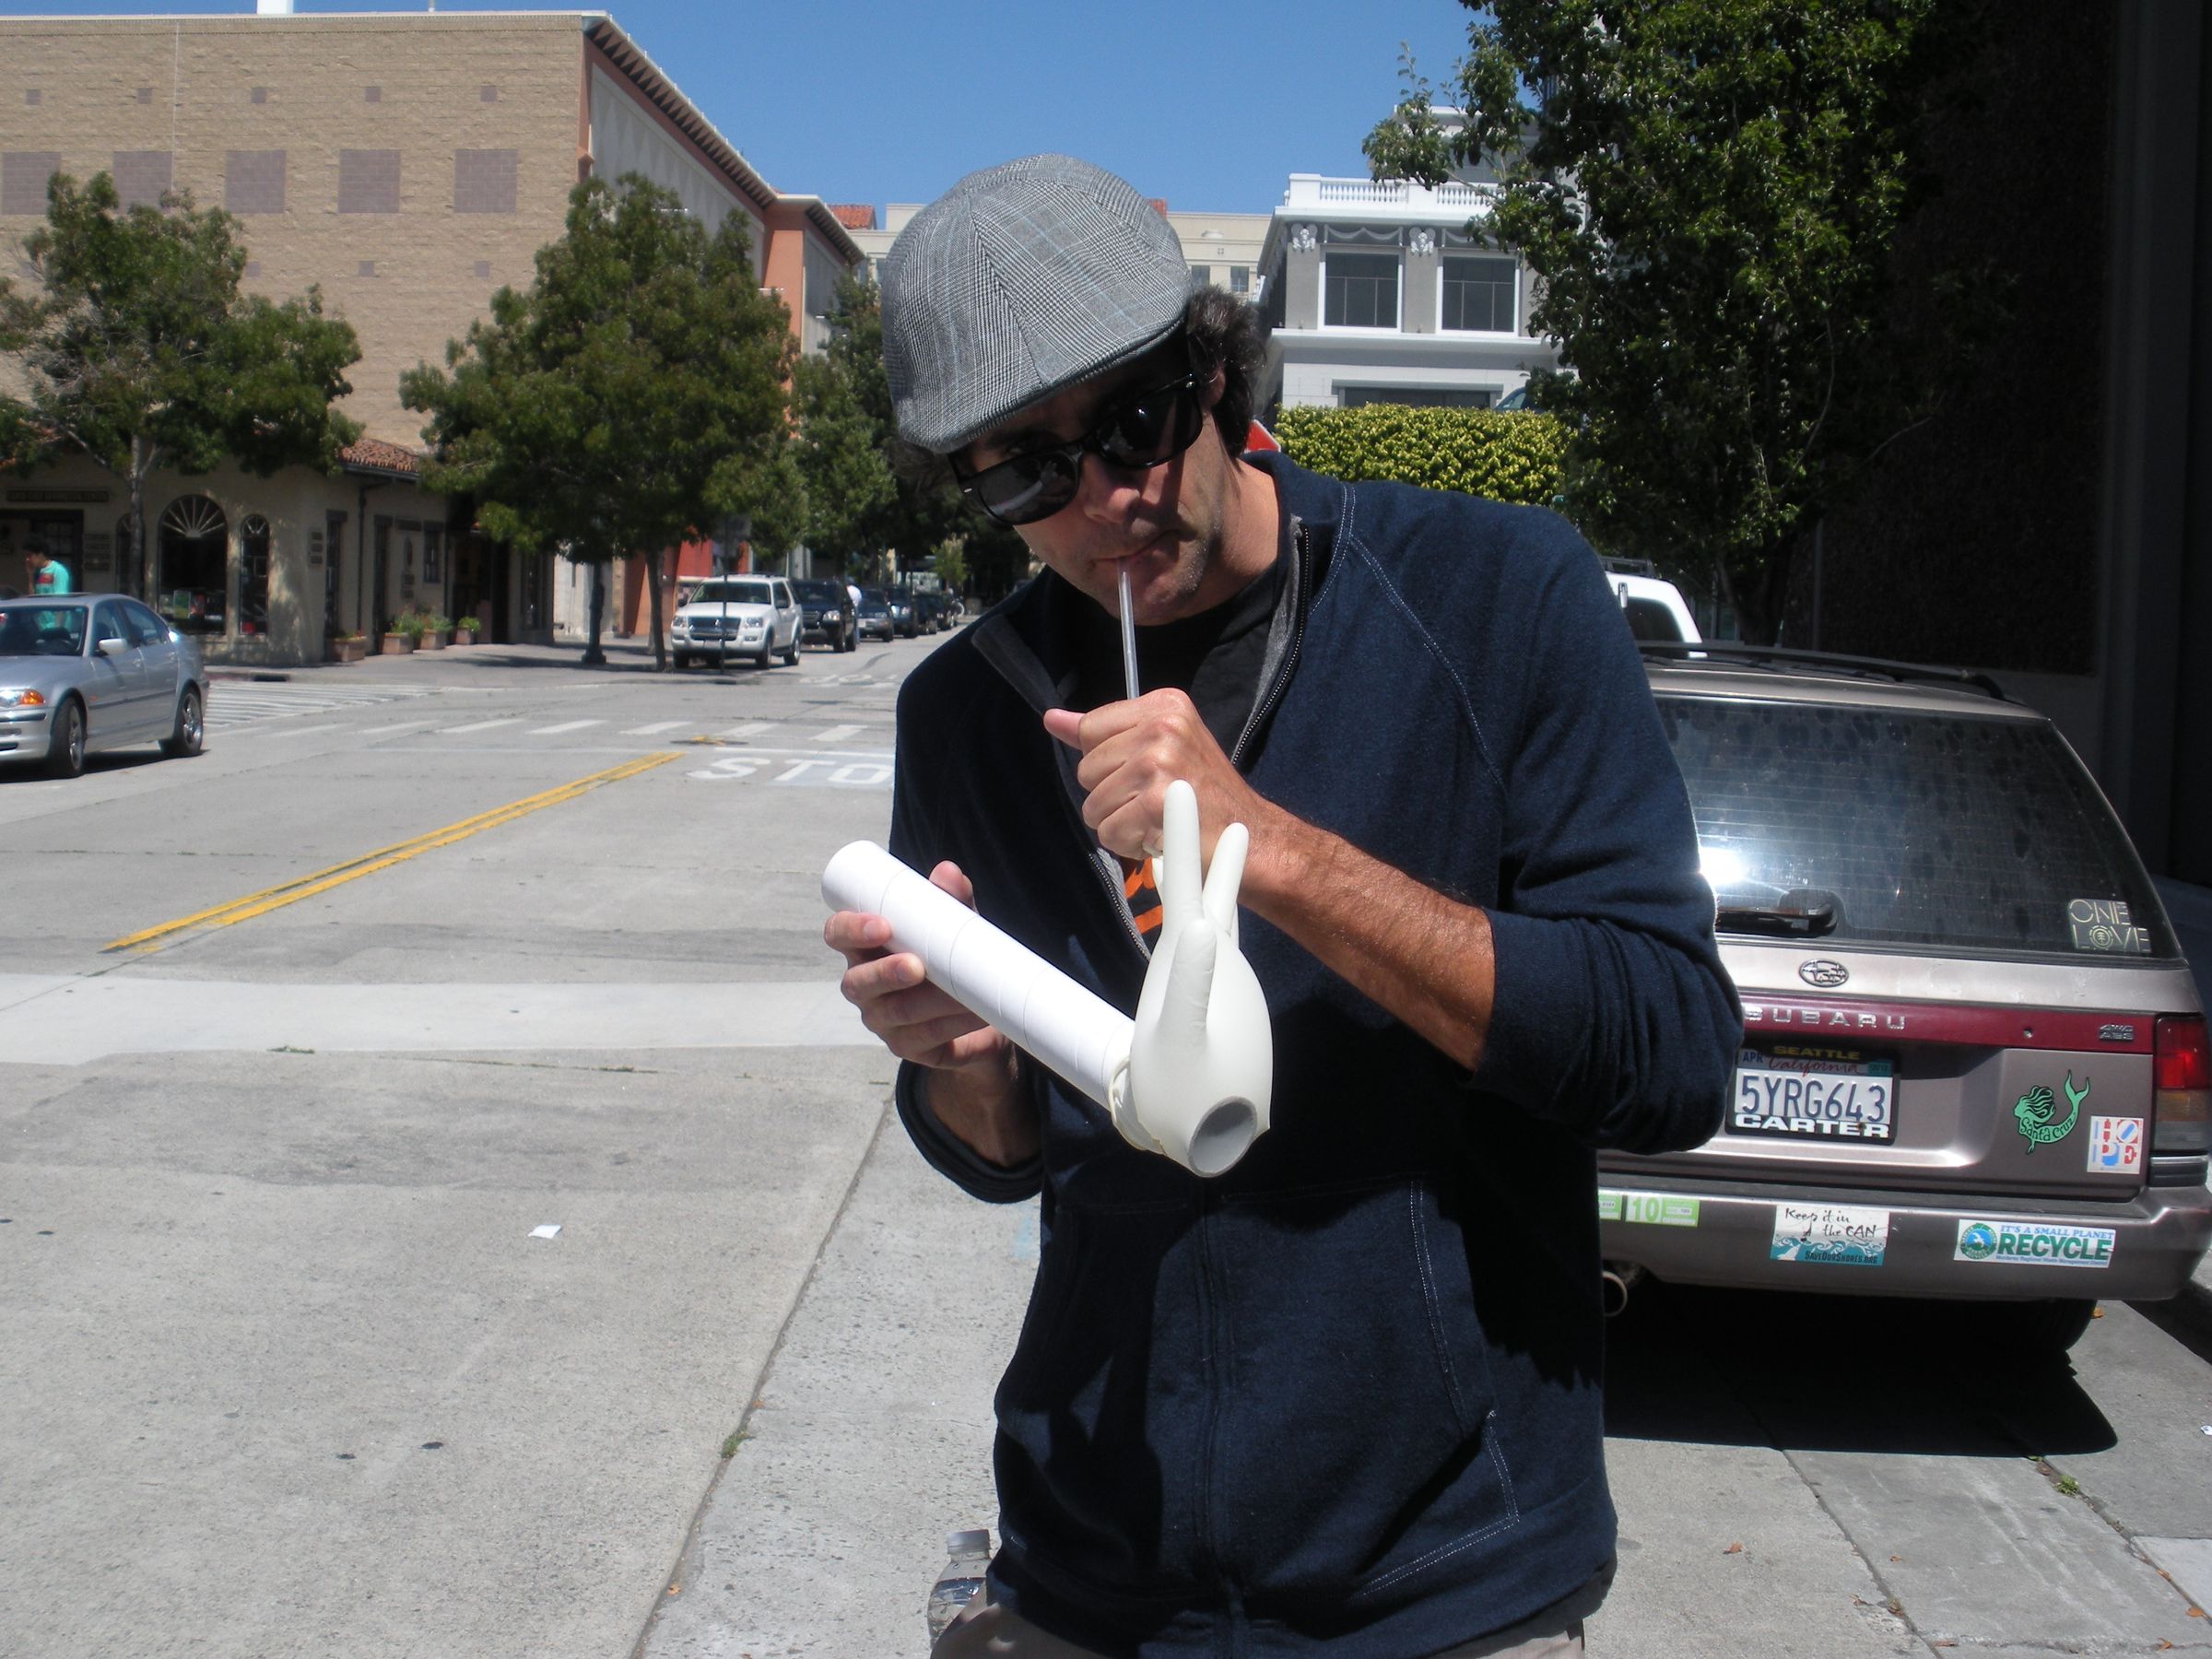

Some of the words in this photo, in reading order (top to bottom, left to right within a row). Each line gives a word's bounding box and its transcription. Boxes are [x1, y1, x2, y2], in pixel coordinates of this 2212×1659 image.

[687, 757, 895, 783] STO
[2069, 899, 2131, 924] ONE
[2072, 924, 2152, 952] LOVE
[1744, 1005, 1905, 1030] SUBARU
[1743, 1049, 1764, 1064] APR
[1773, 1046, 1861, 1060] SEATTLE
[1767, 1057, 1861, 1077] California
[1740, 1074, 1887, 1123] 5YRG643
[1735, 1113, 1889, 1138] CARTER
[2020, 1117, 2051, 1142] Santa
[2053, 1117, 2075, 1139] Cruz
[1632, 1197, 1660, 1222] 10
[1785, 1207, 1818, 1228] Keep
[1822, 1210, 1832, 1223] it
[1836, 1210, 1850, 1223] in
[1823, 1224, 1841, 1236] the
[1846, 1225, 1877, 1238] CAN
[2000, 1225, 2021, 1233] IT'S
[2024, 1226, 2031, 1234] A
[2034, 1227, 2069, 1237] SMALL
[2071, 1230, 2114, 1240] PLANET
[1997, 1232, 2112, 1261] RECYCLE
